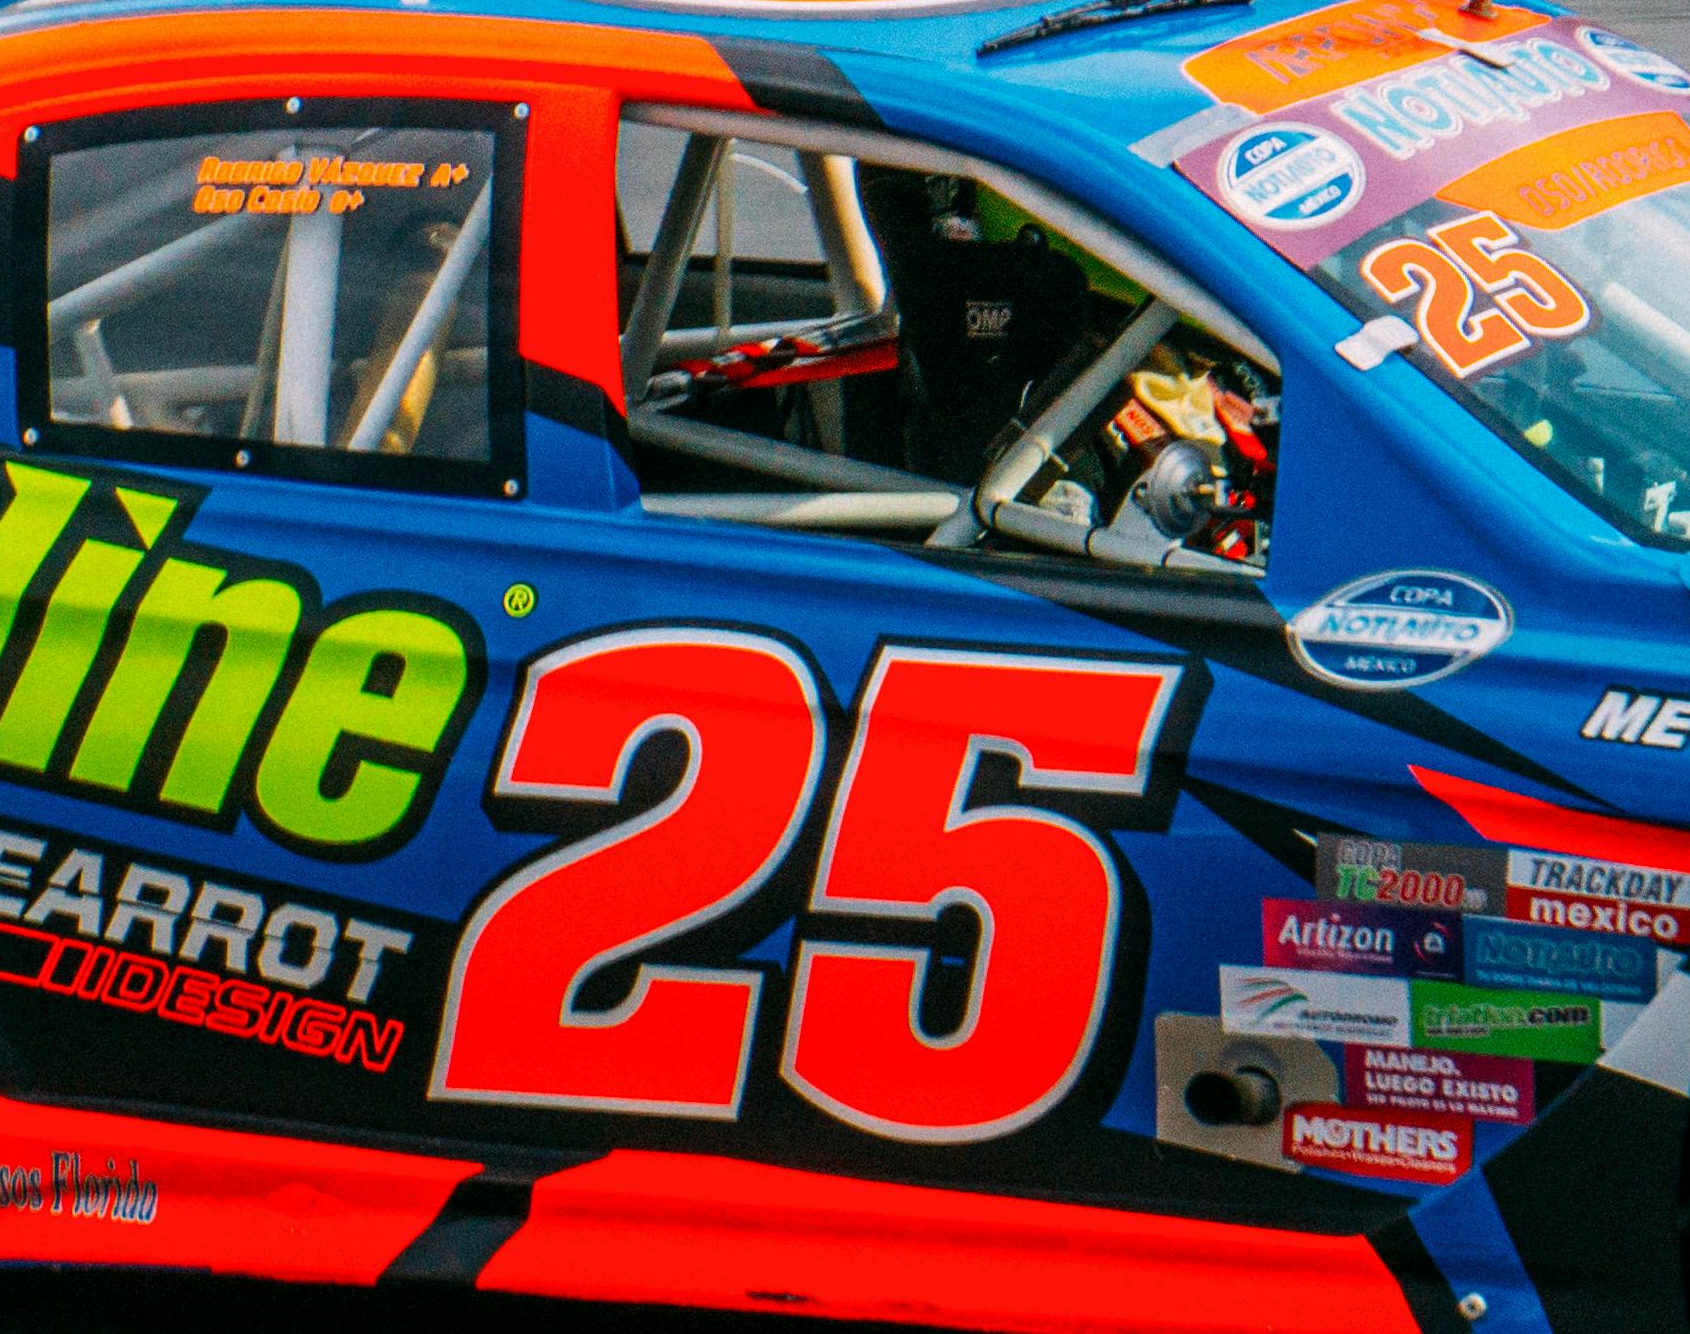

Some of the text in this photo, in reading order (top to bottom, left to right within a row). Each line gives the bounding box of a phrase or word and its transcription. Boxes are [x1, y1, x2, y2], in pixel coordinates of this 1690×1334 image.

[1360, 210, 1592, 380] 25
[429, 627, 1184, 1147] 25
[1531, 858, 1685, 905] TRACKDAY
[1277, 914, 1396, 953] Artizon
[1528, 897, 1679, 940] mexico
[1365, 1070, 1520, 1103] LUEGO EXISTO
[1293, 1114, 1459, 1160] MOTHERS
[50, 1149, 159, 1224] Florido
